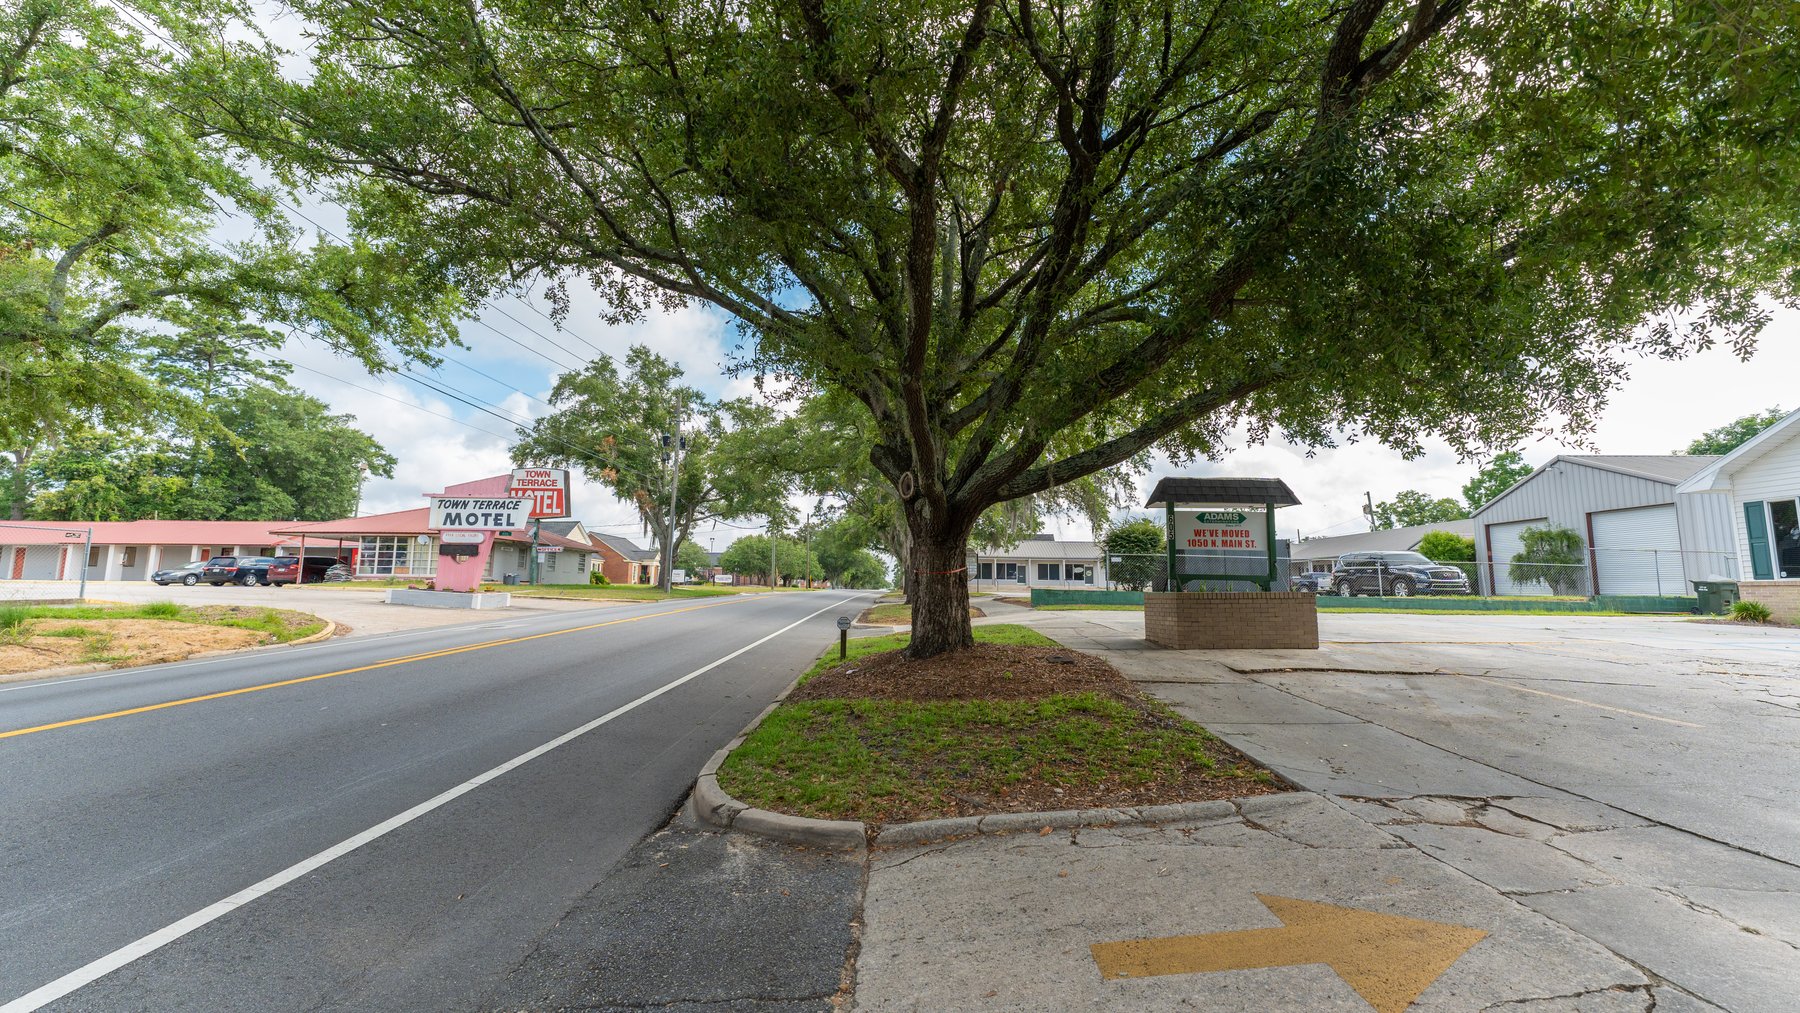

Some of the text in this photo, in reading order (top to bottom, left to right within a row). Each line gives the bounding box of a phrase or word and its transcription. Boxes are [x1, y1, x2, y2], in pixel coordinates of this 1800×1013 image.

[525, 470, 551, 478] TOWN
[517, 479, 558, 487] TERRACE
[438, 500, 521, 510] TOWN TERRACE
[443, 512, 515, 527] MOTEL
[1194, 529, 1250, 538] WE'VE MOVED
[1187, 539, 1257, 548] 1050 N. MAIN ST.
